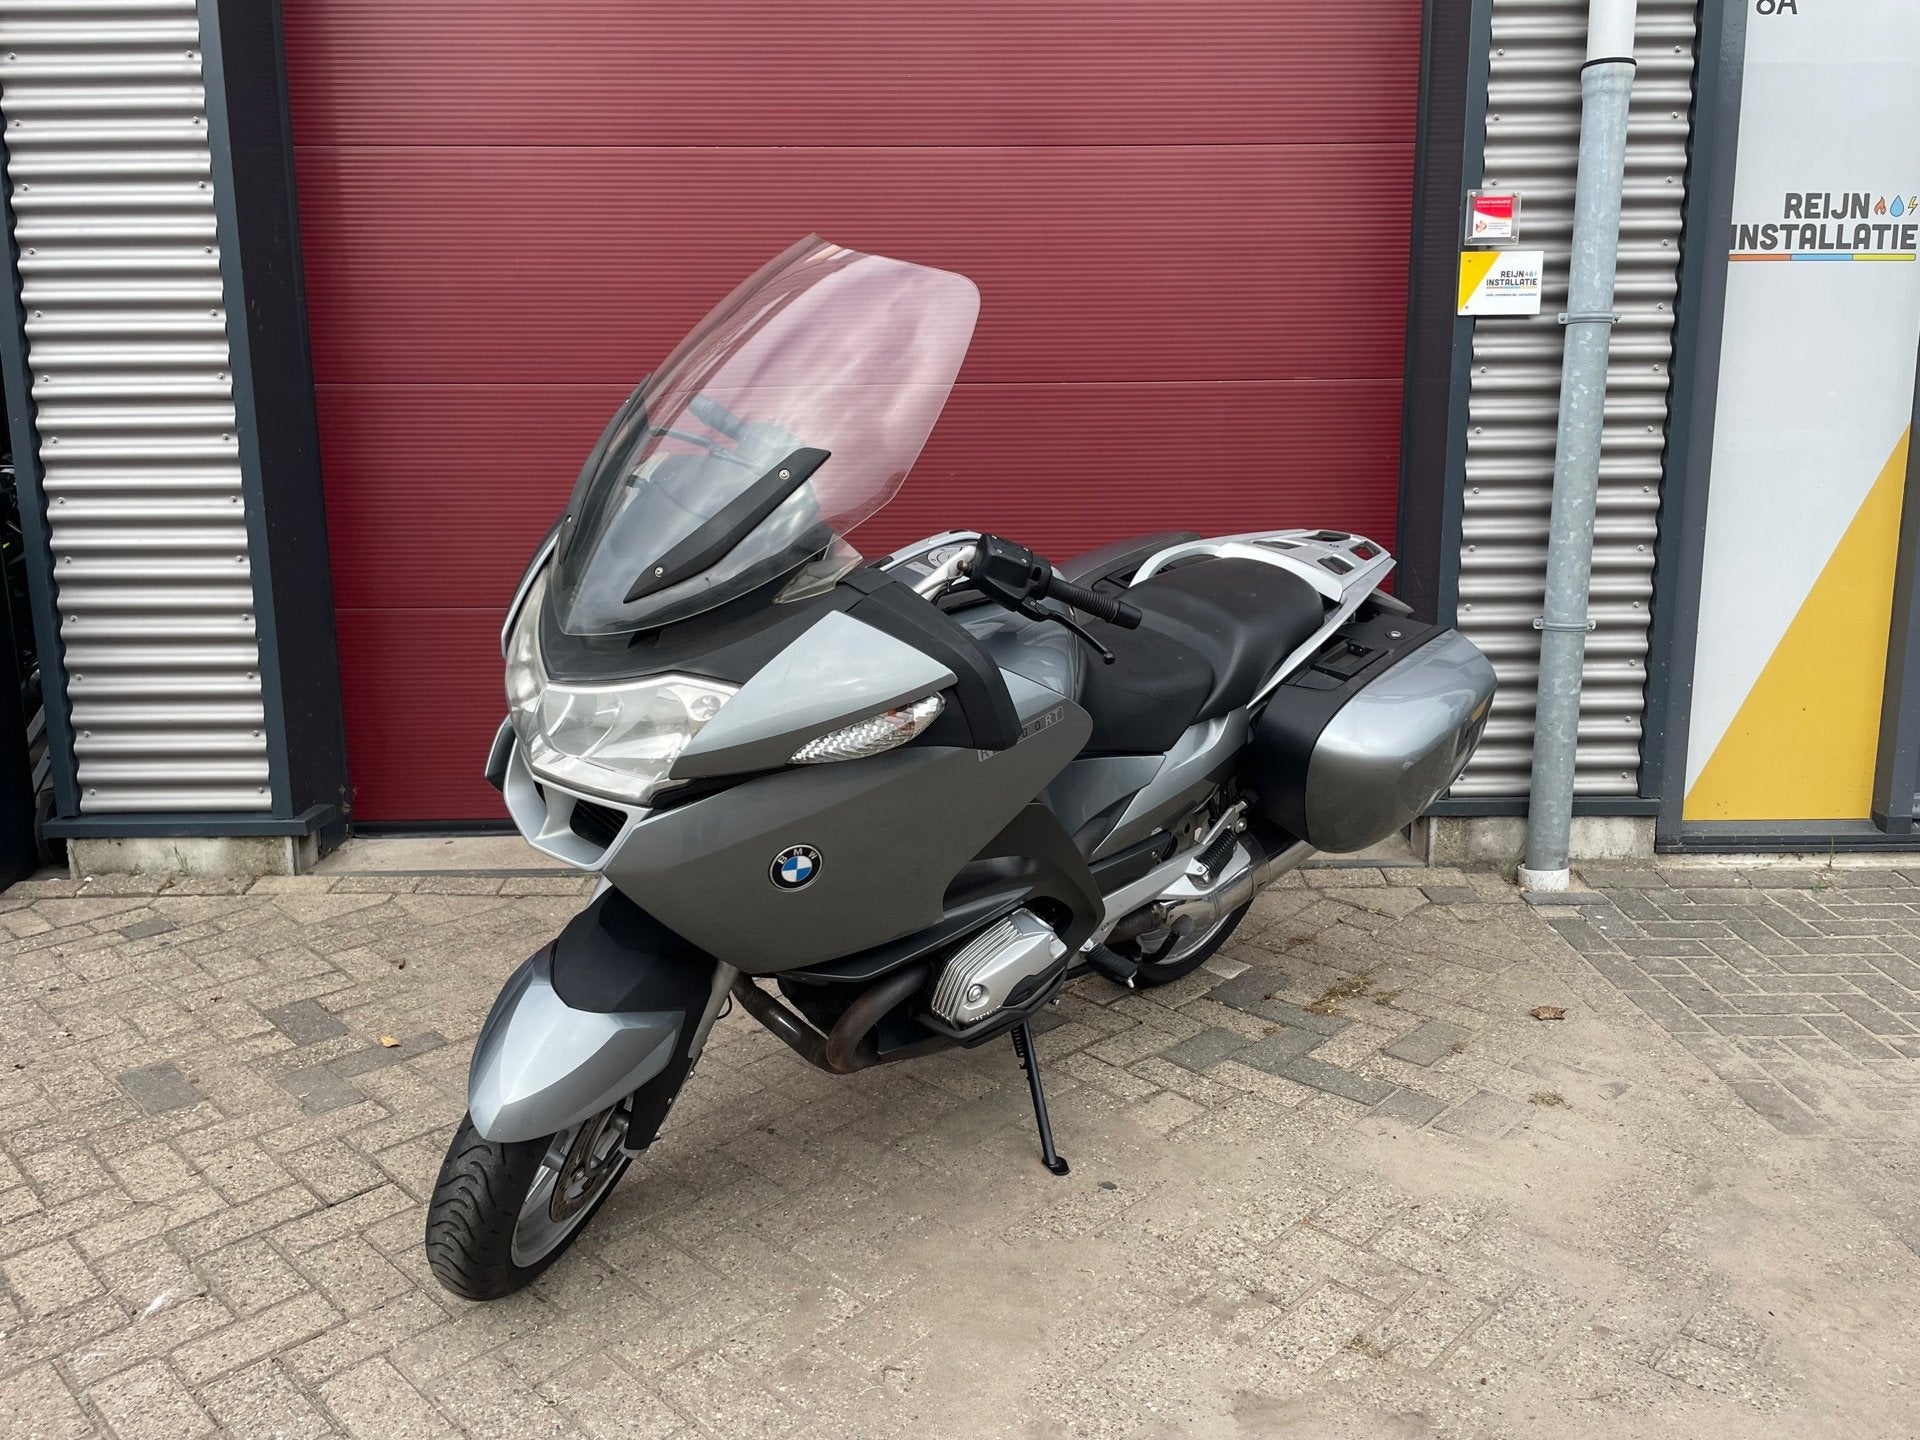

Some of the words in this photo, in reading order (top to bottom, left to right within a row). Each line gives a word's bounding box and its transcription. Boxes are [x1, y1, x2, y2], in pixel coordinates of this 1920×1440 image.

[1784, 193, 1870, 219] REIJN
[1731, 224, 1918, 250] INSTALLATIE
[1500, 270, 1524, 278] REIJN
[777, 848, 818, 864] BMW
